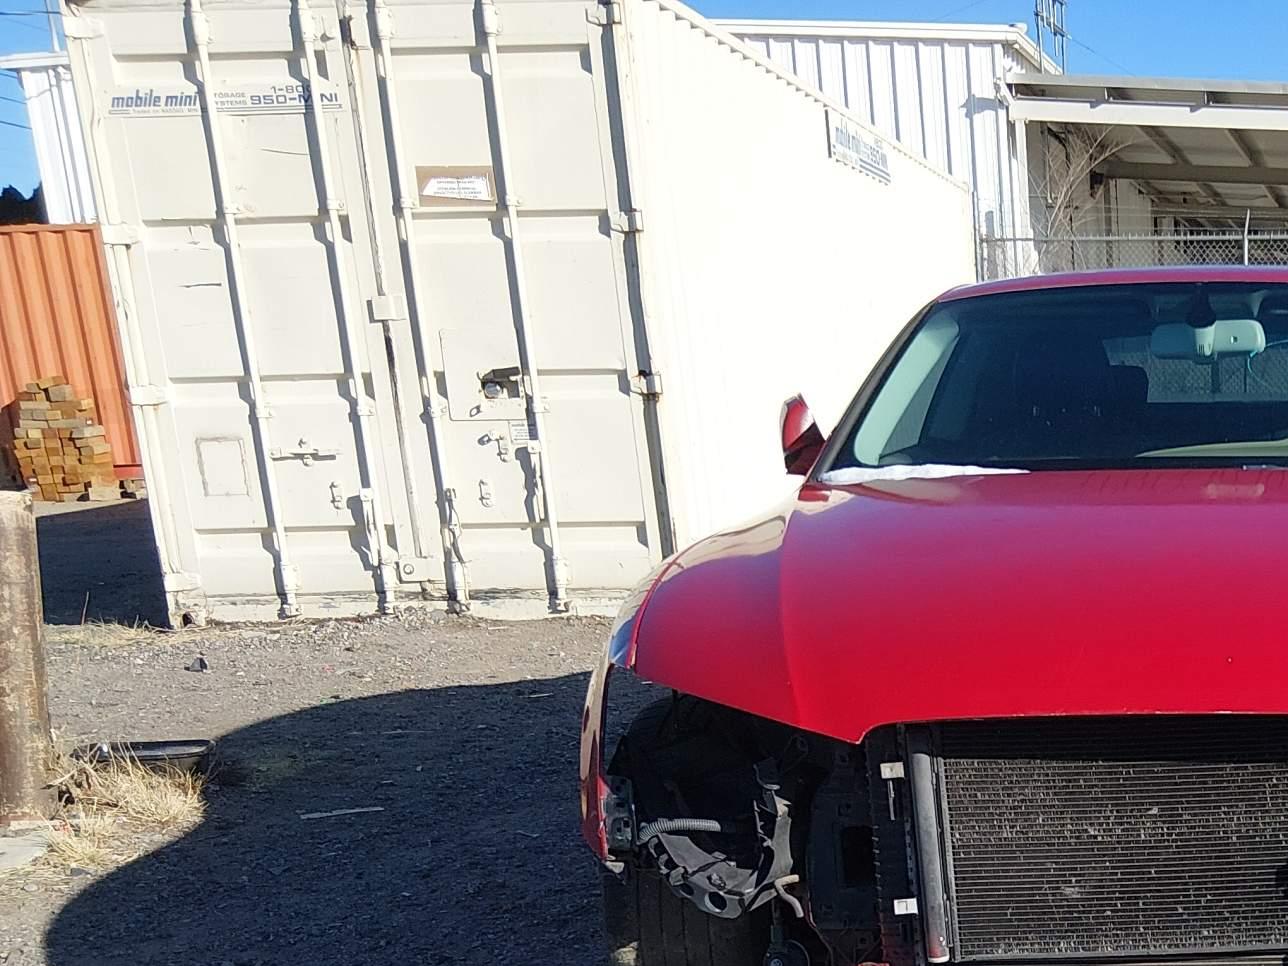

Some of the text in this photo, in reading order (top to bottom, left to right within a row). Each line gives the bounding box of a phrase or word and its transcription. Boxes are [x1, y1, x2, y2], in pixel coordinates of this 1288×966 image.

[111, 89, 199, 108] mobile mini
[250, 93, 338, 106] 950-MNI
